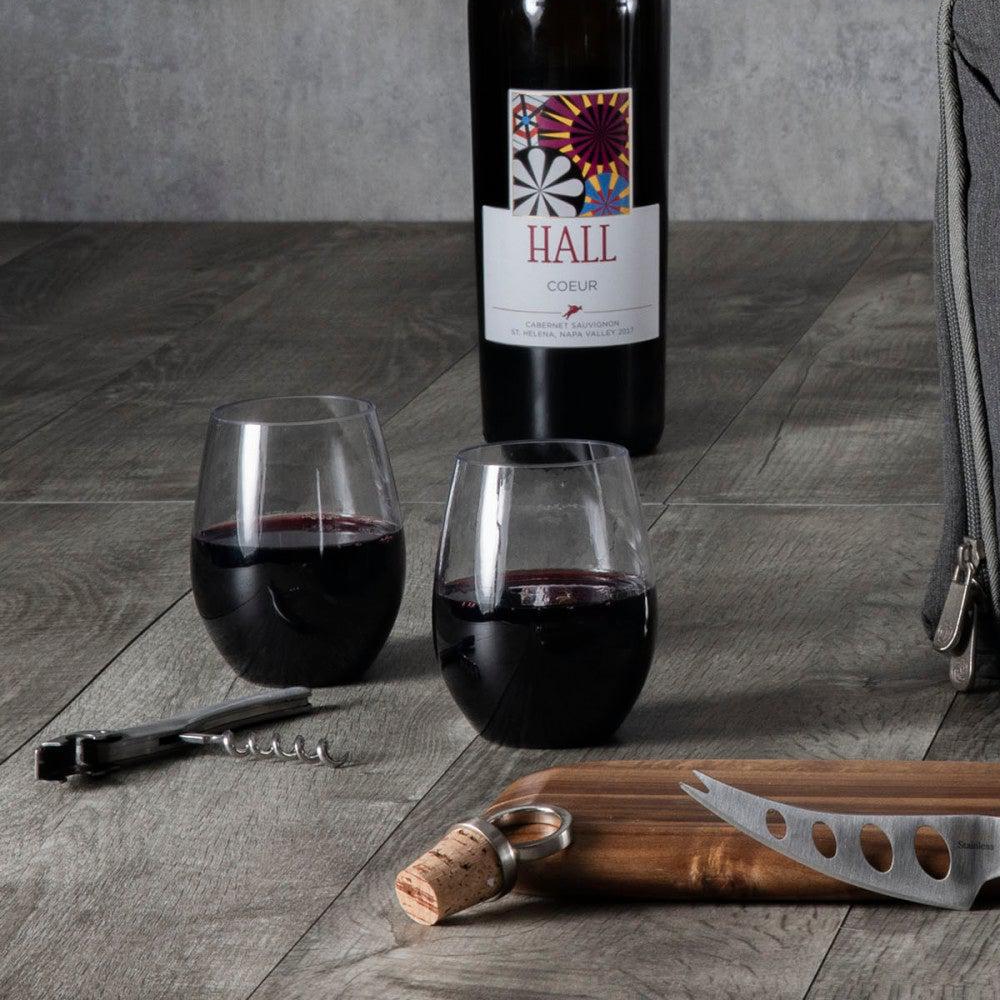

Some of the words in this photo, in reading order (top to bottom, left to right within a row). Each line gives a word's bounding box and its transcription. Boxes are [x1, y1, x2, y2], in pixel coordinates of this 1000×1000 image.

[527, 224, 617, 263] HALL
[547, 280, 598, 292] COEUR
[525, 320, 568, 329] CABERNET
[571, 320, 620, 329] SAUVIGNON
[586, 328, 615, 337] VALLEY
